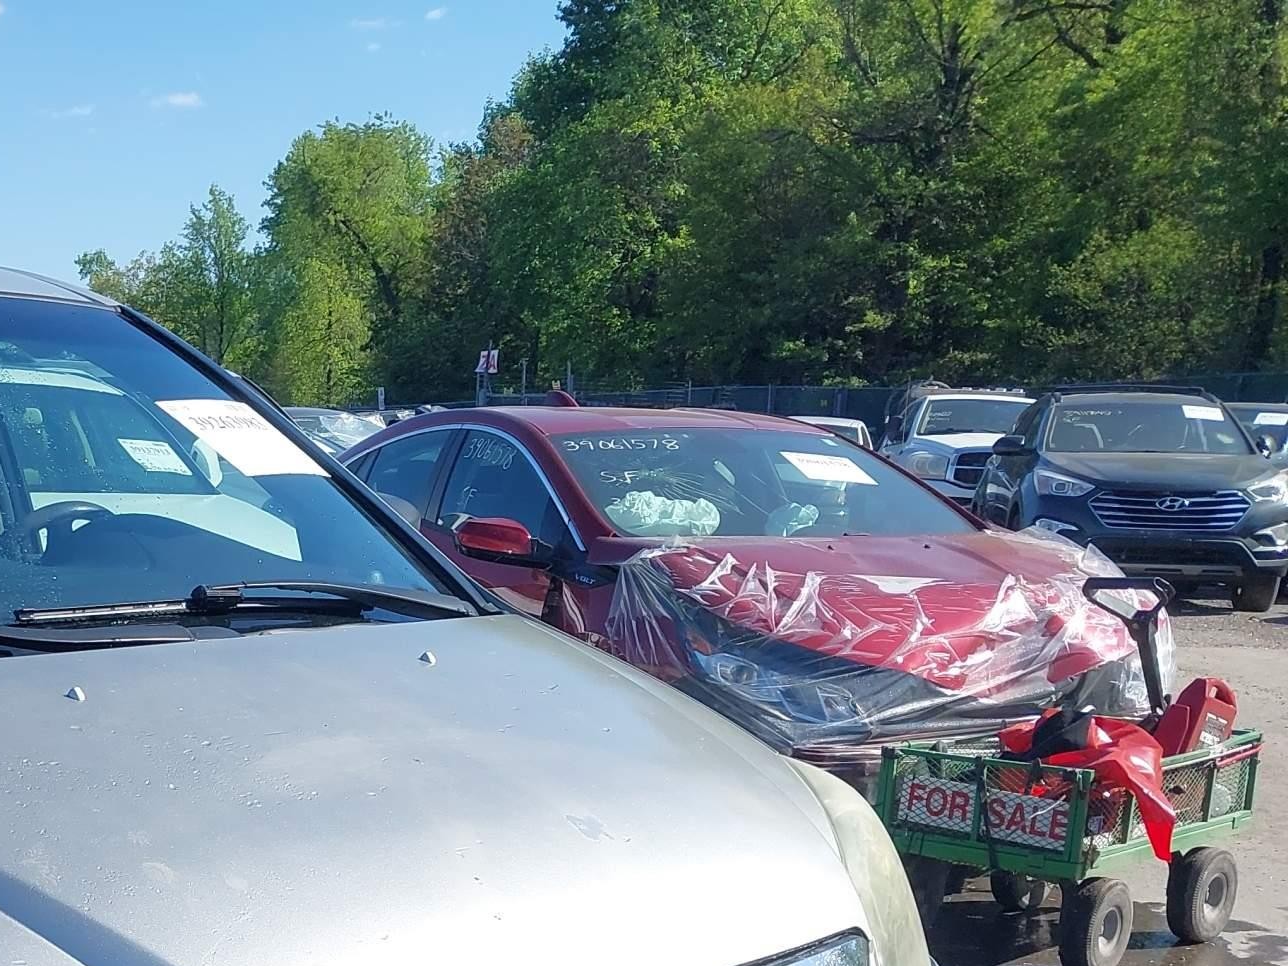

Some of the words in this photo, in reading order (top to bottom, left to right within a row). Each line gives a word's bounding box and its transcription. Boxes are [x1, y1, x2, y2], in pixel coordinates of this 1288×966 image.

[563, 438, 680, 451] 39061578
[906, 783, 971, 823] FOR
[987, 797, 1069, 841] SALE
